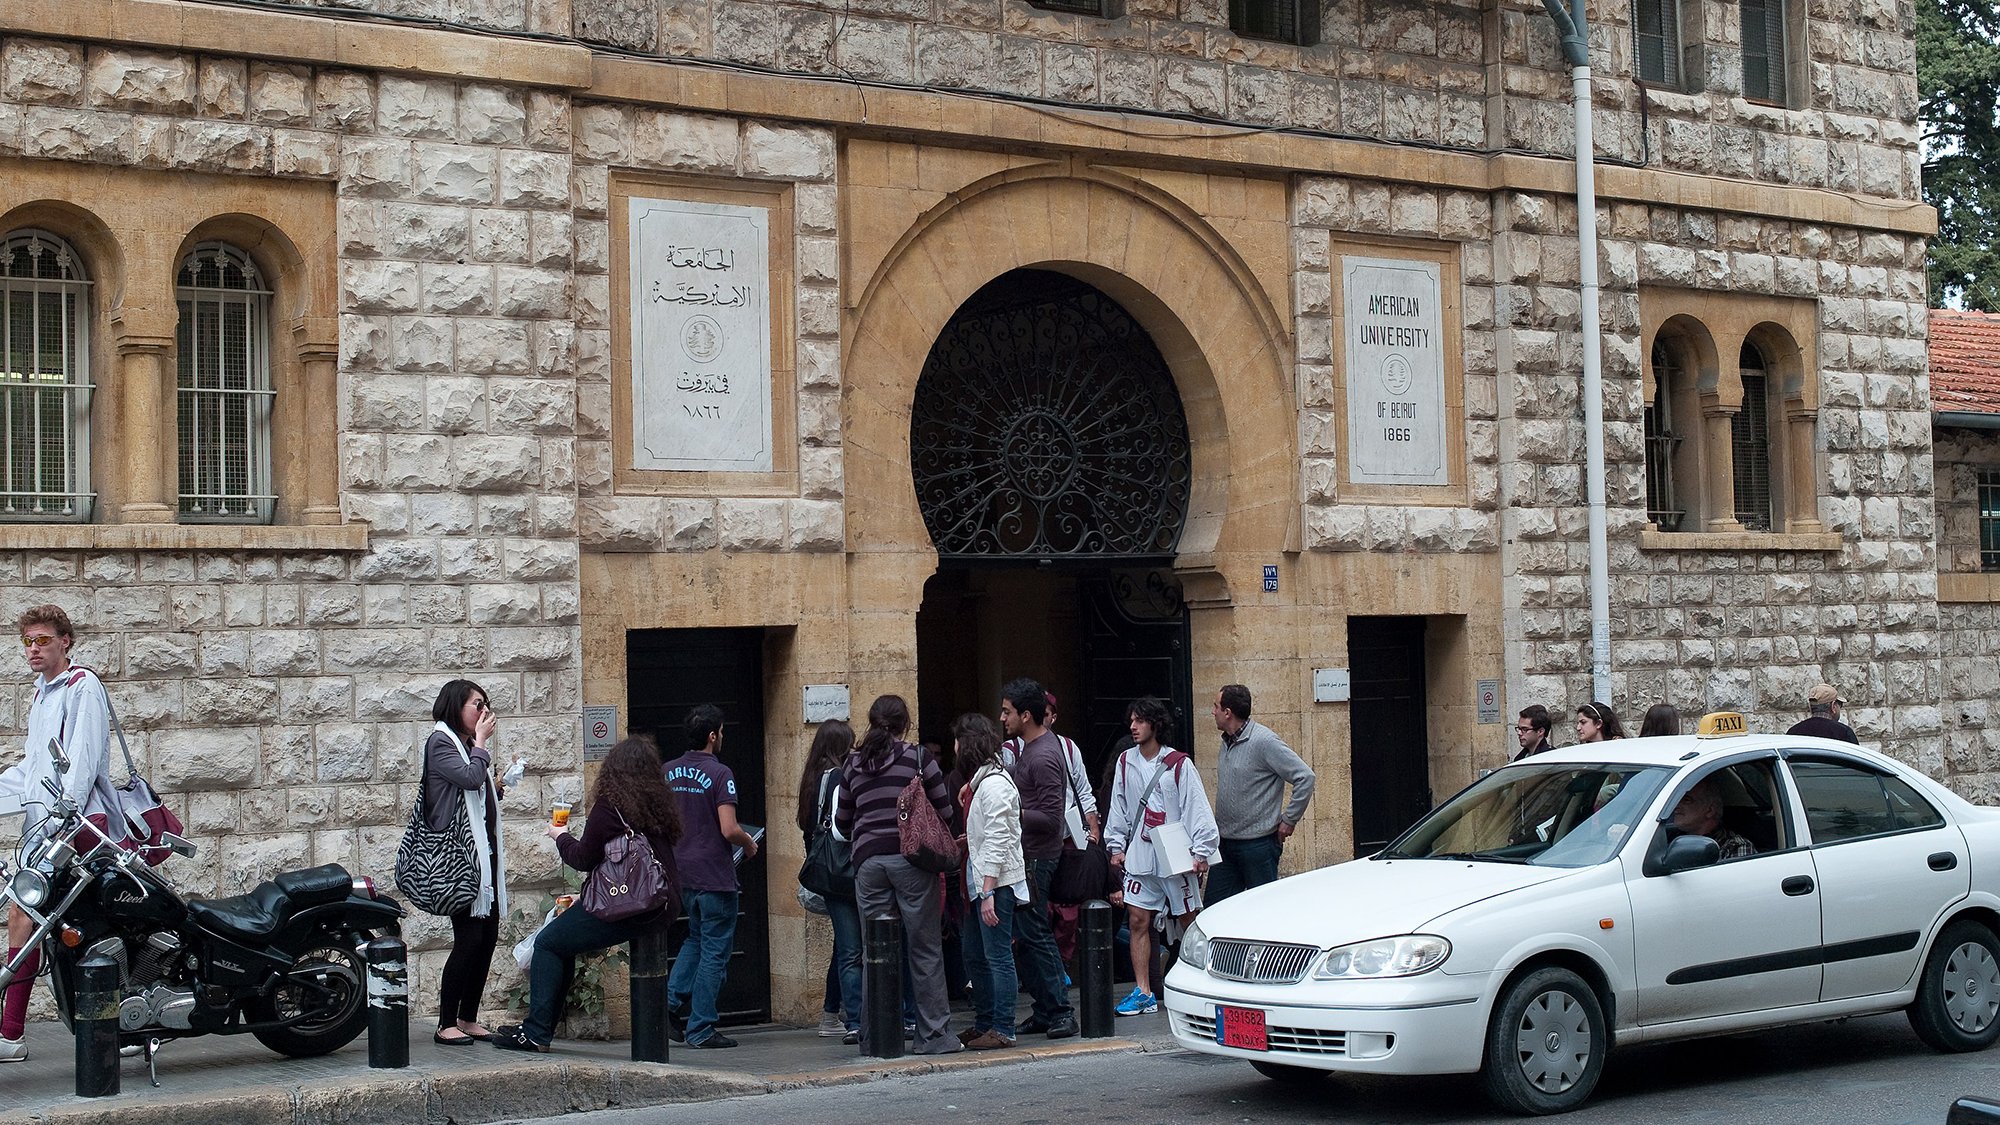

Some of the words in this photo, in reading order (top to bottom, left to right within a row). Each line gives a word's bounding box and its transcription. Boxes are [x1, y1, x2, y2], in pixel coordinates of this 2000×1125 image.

[1368, 295, 1419, 317] AMERICAN
[1360, 325, 1429, 348] UNIVERSITY
[682, 404, 720, 420] ١٨٦٦
[1377, 401, 1386, 419] OF
[1391, 402, 1416, 419] BEIRUT
[1383, 427, 1411, 442] 1866
[1265, 580, 1278, 590] 179
[1715, 716, 1742, 732] TAXI
[727, 779, 736, 795] 8
[1126, 878, 1142, 895] 10
[1229, 1010, 1263, 1026] 391582
